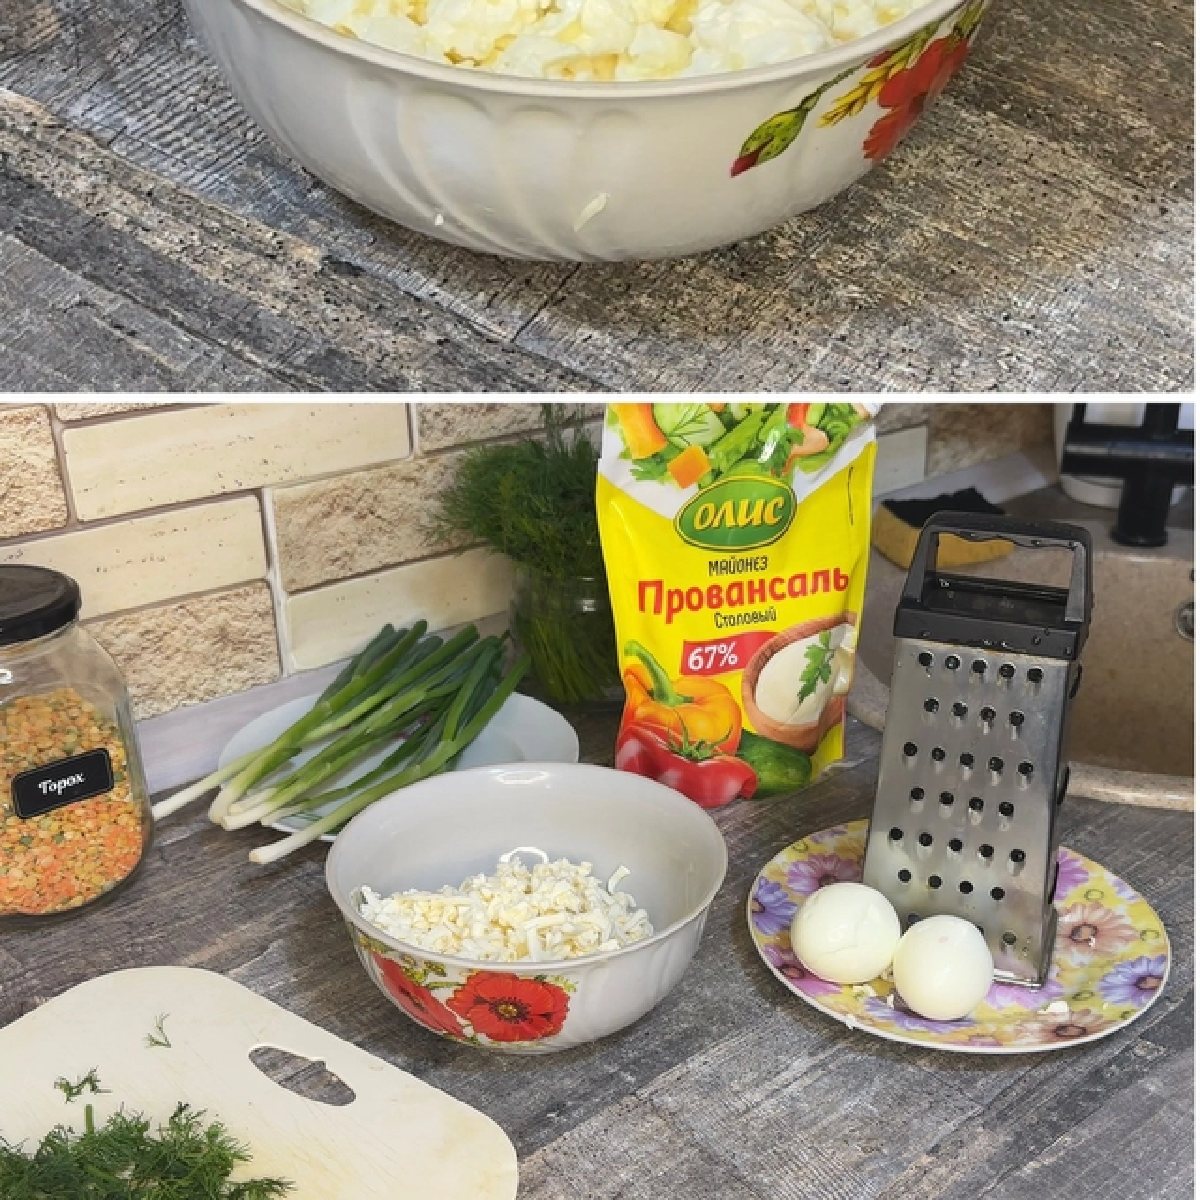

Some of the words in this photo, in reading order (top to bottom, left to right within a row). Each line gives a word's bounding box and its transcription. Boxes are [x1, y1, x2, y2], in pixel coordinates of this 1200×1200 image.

[708, 555, 769, 577] МАЙОНЕЗ
[638, 568, 849, 624] Провансаль
[714, 606, 777, 628] Столовый
[687, 641, 739, 671] 67%
[39, 772, 85, 795] Горох
